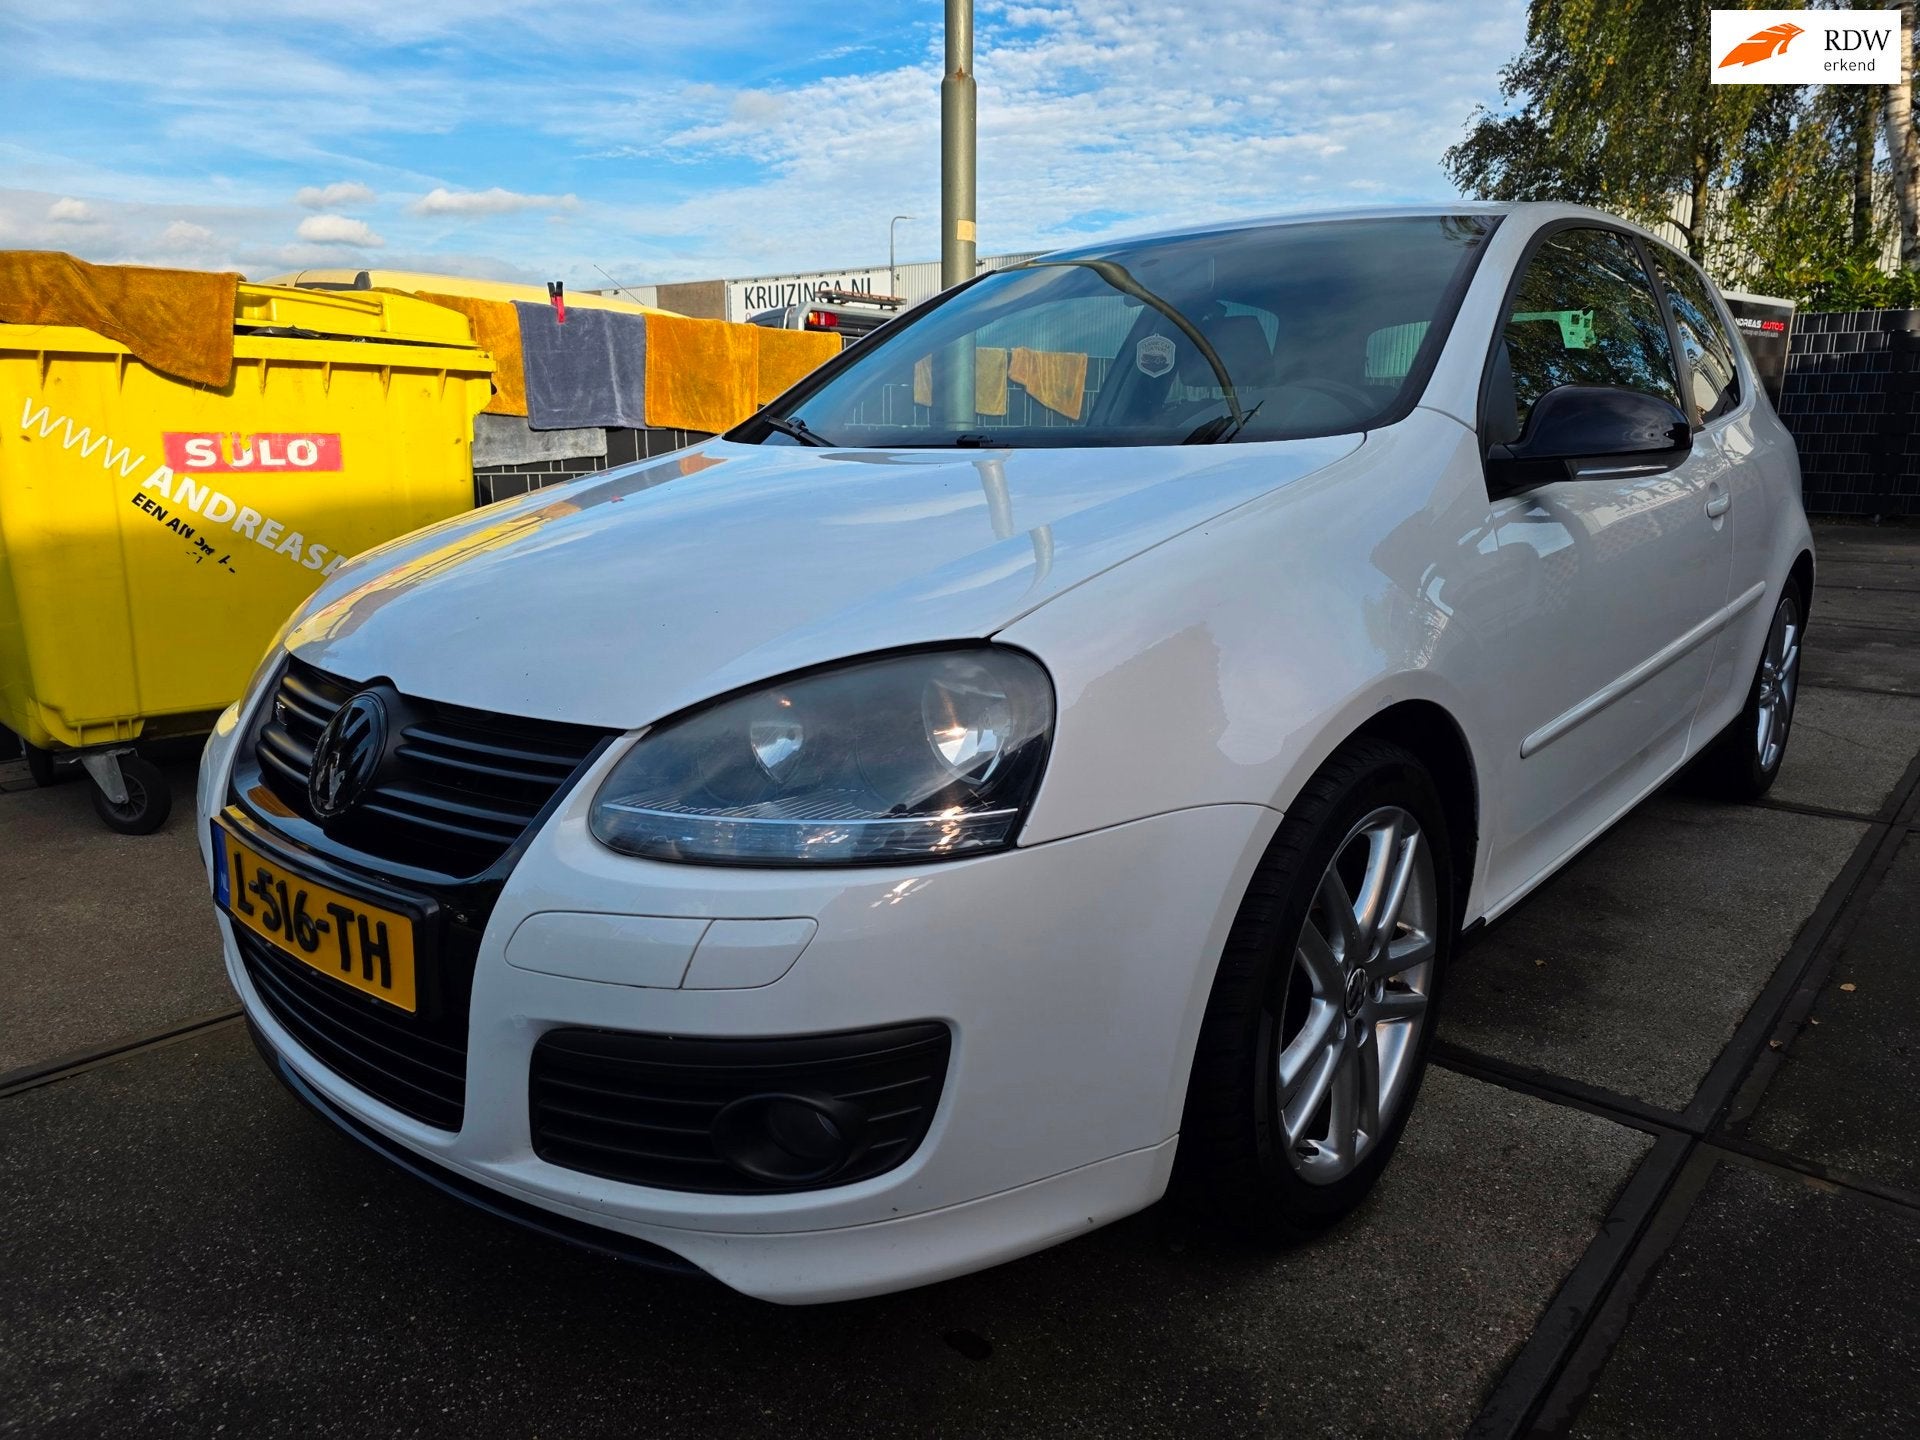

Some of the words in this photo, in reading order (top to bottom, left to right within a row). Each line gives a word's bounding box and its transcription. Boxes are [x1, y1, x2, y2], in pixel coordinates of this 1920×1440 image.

[1733, 317, 1762, 329] NDREAS
[1762, 320, 1785, 331] AUTOS
[131, 492, 169, 522] EEN
[233, 853, 392, 989] L-516-TH
